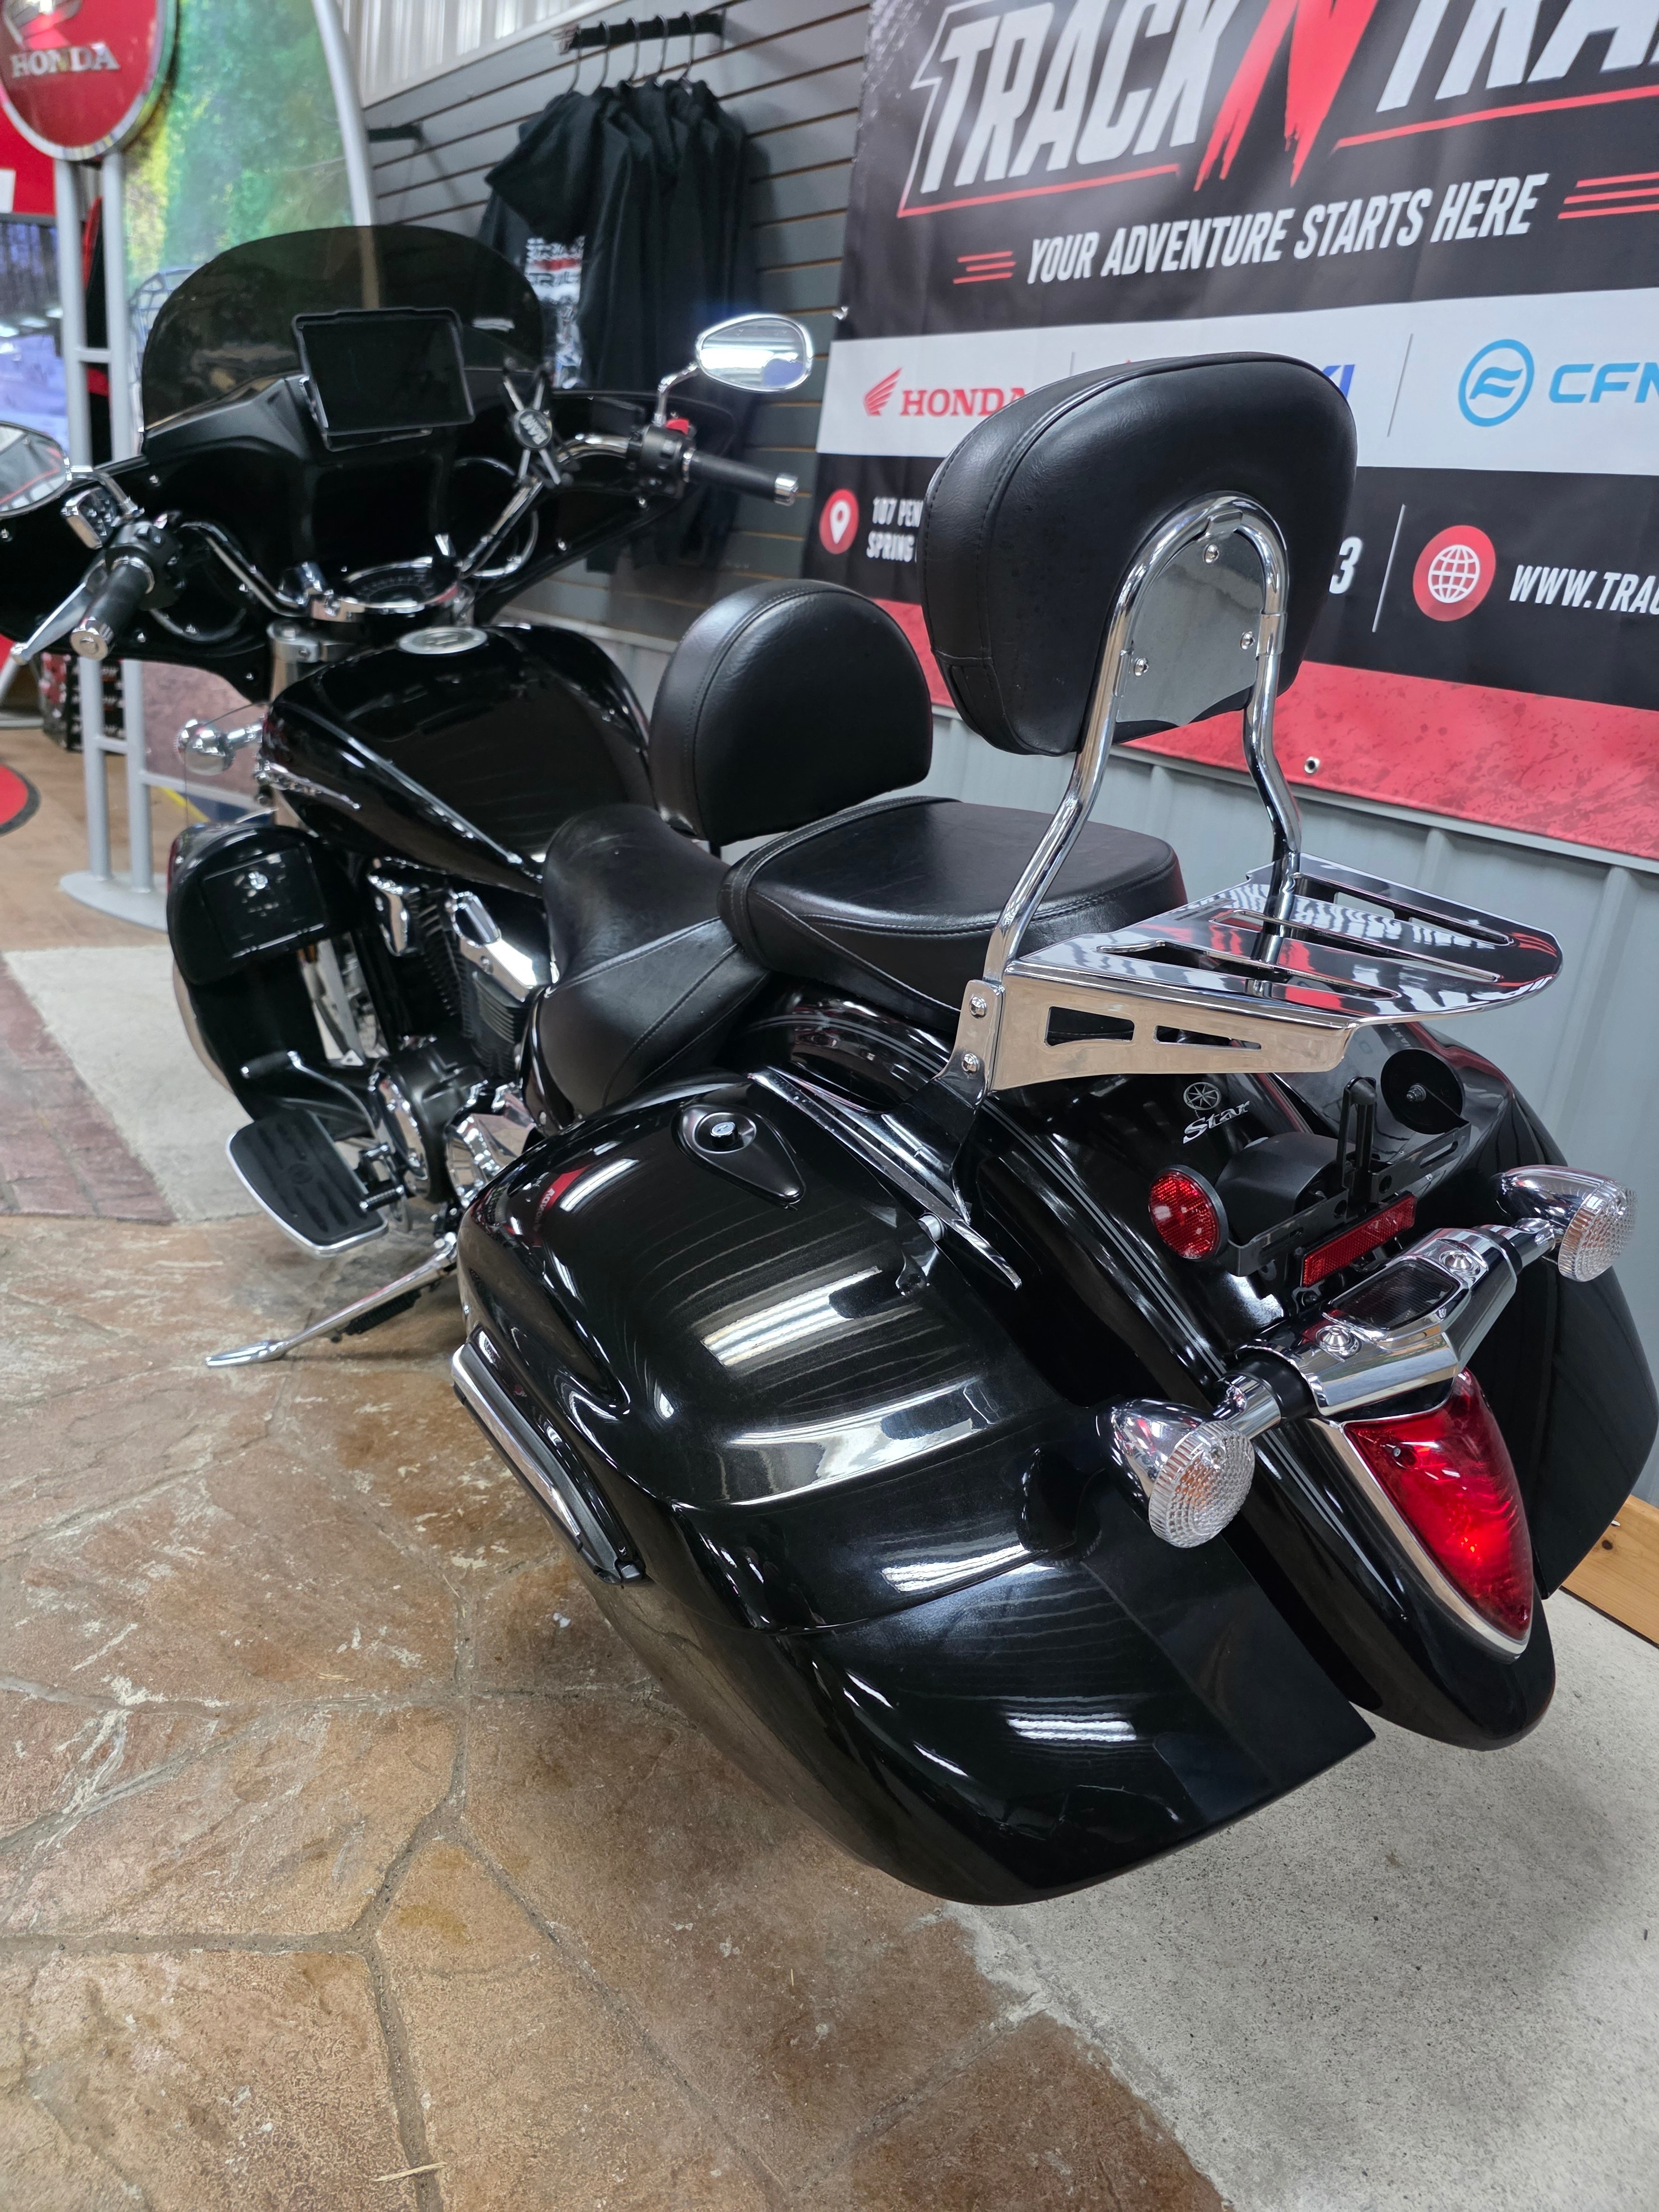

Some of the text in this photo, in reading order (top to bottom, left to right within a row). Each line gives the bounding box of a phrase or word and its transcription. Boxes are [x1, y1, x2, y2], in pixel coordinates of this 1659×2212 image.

[10, 41, 121, 78] HONDA
[920, 0, 1240, 194] TRACK
[1027, 173, 1550, 284] YOUR ADVENTURE STARTS HERE
[872, 497, 898, 525] 107
[866, 531, 917, 563] SPRING
[1183, 1100, 1250, 1144] Star
